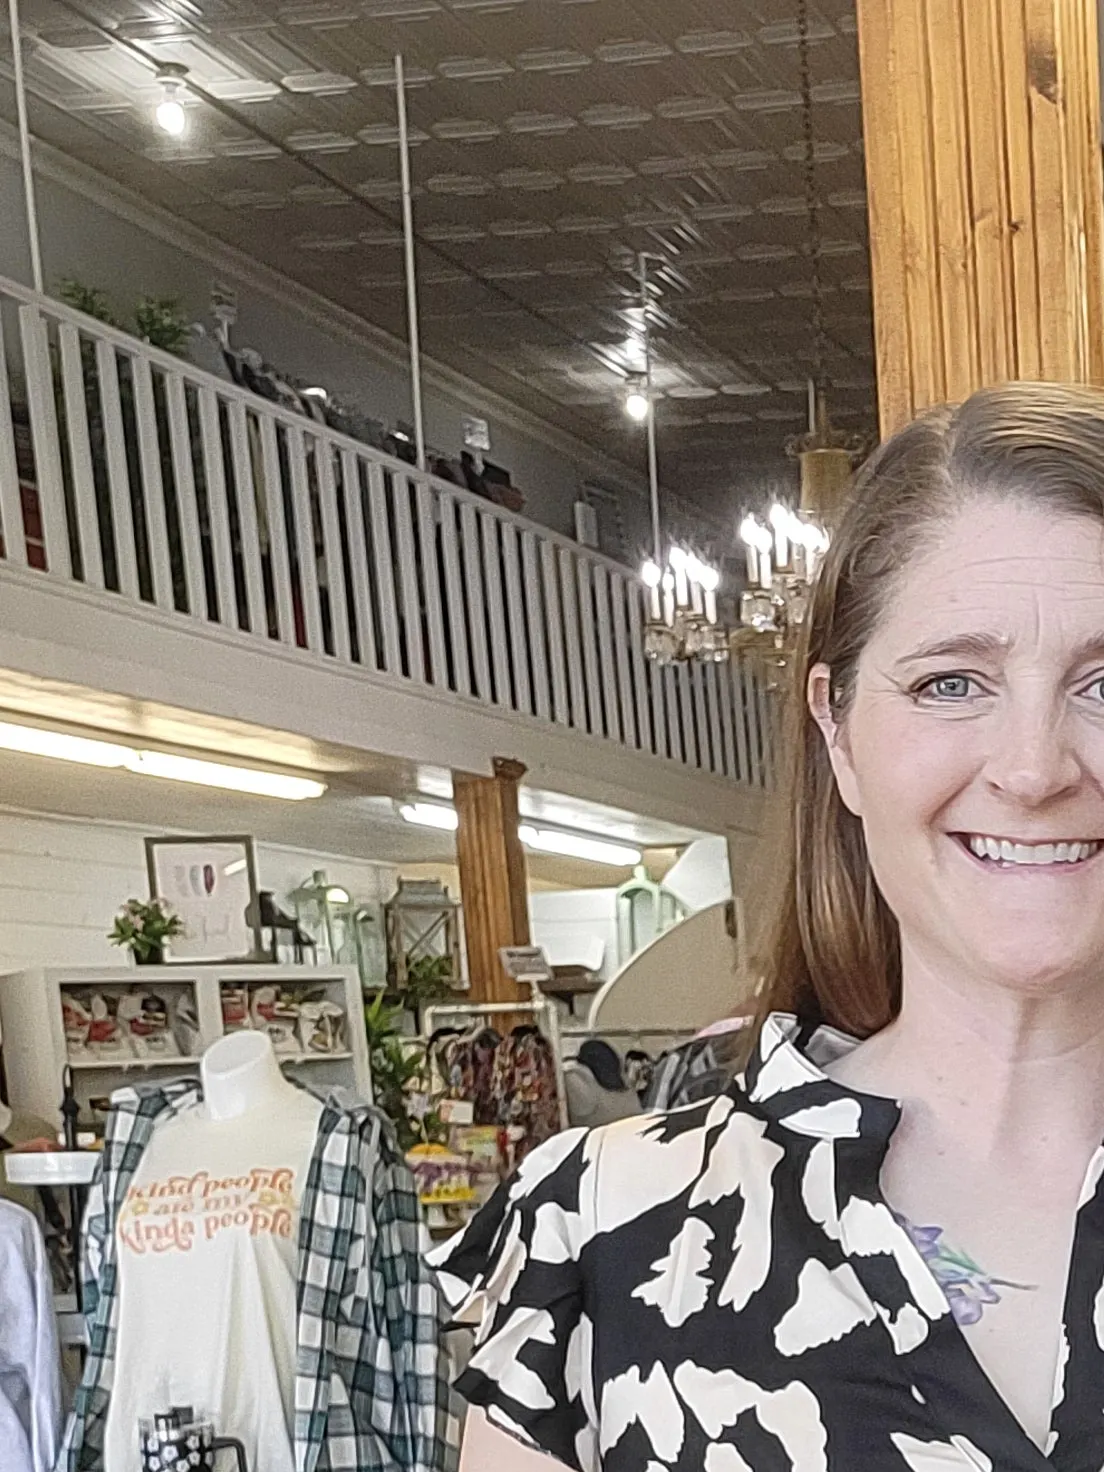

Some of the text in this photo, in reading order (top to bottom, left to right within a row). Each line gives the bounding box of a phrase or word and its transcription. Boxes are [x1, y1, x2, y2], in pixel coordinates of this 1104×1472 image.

[127, 1167, 294, 1201] kind people
[153, 1200, 195, 1216] are
[204, 1203, 292, 1239] people
